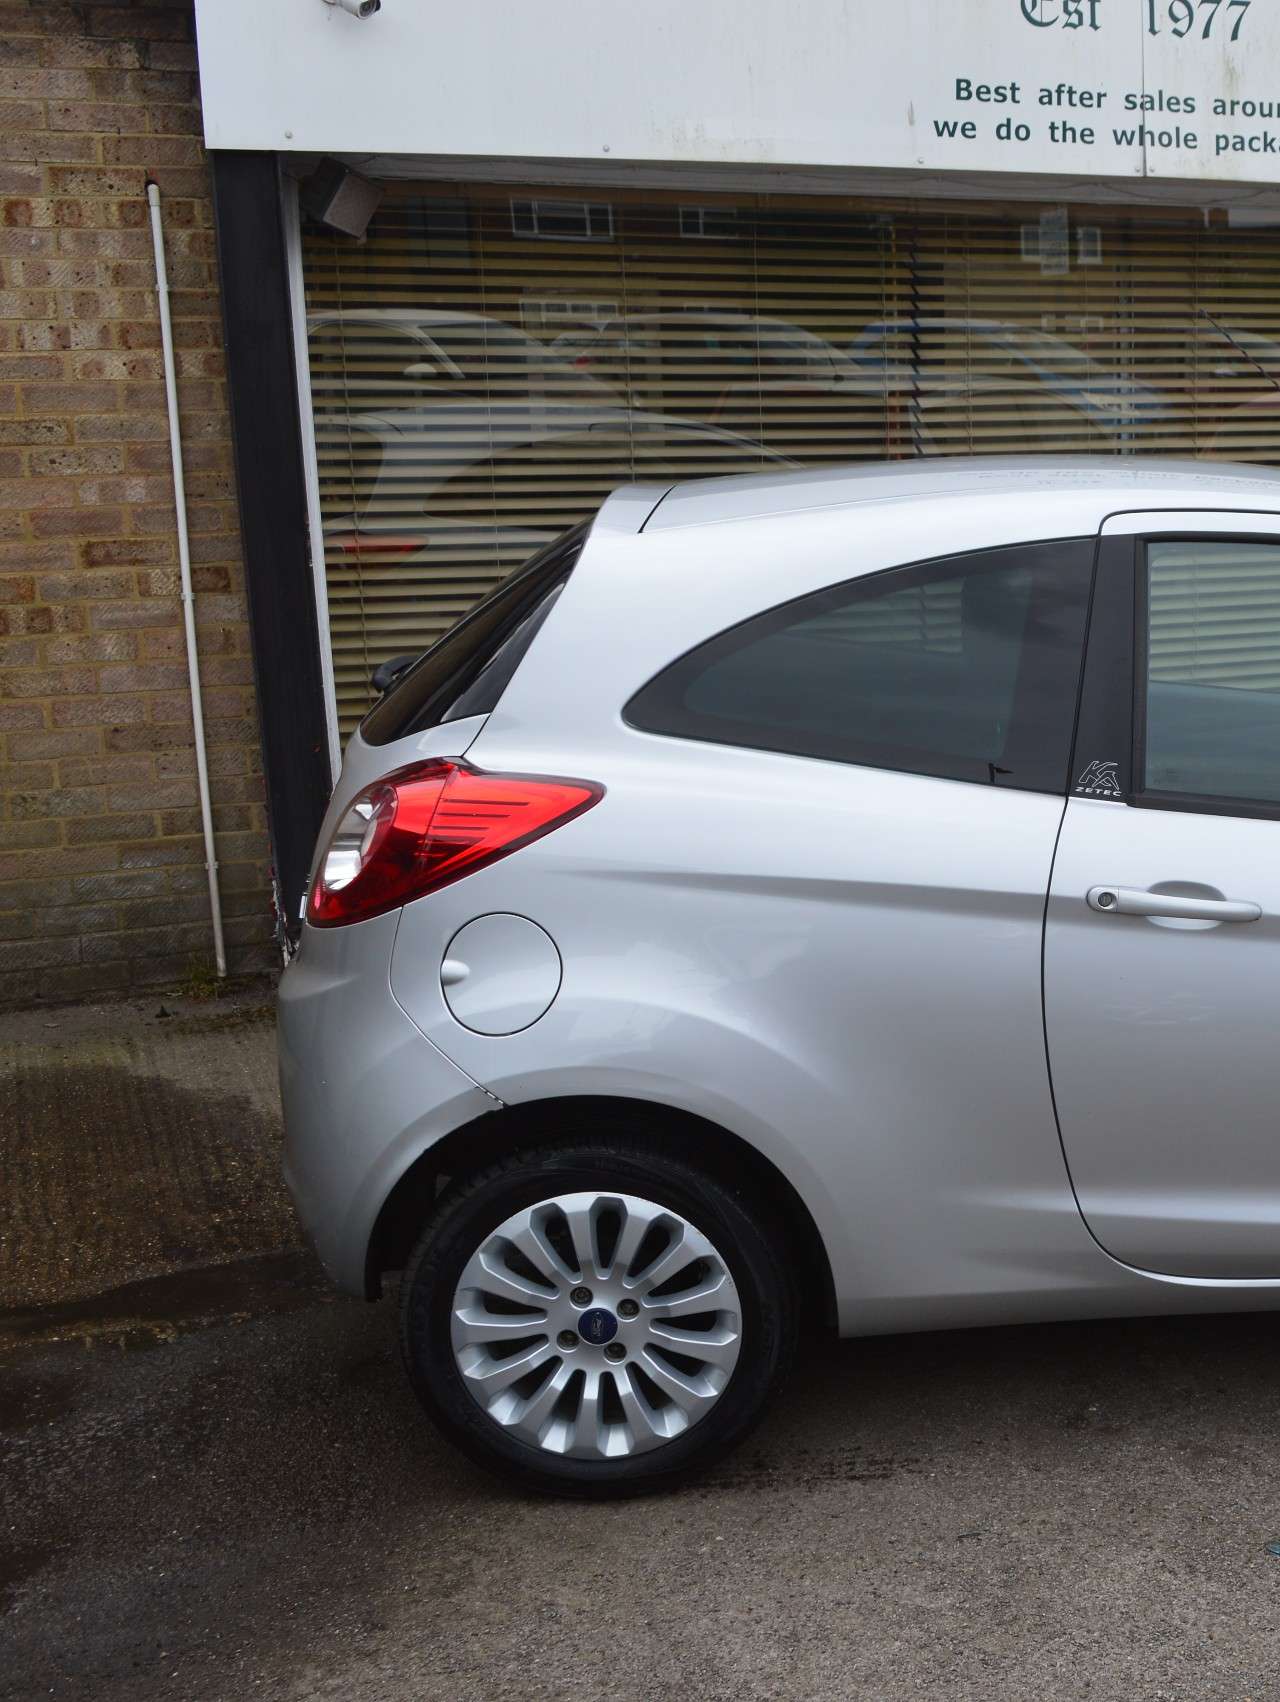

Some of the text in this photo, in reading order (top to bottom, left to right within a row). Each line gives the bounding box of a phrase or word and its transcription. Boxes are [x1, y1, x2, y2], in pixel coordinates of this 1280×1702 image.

[1020, 0, 1250, 42] Est 1977
[955, 78, 1020, 104] Best
[1038, 83, 1107, 109] after
[1124, 90, 1196, 115] sales
[933, 119, 977, 139] we
[995, 118, 1031, 142] do
[1048, 121, 1095, 145] the
[1113, 125, 1198, 149] whole
[1075, 786, 1123, 797] ZETEC
